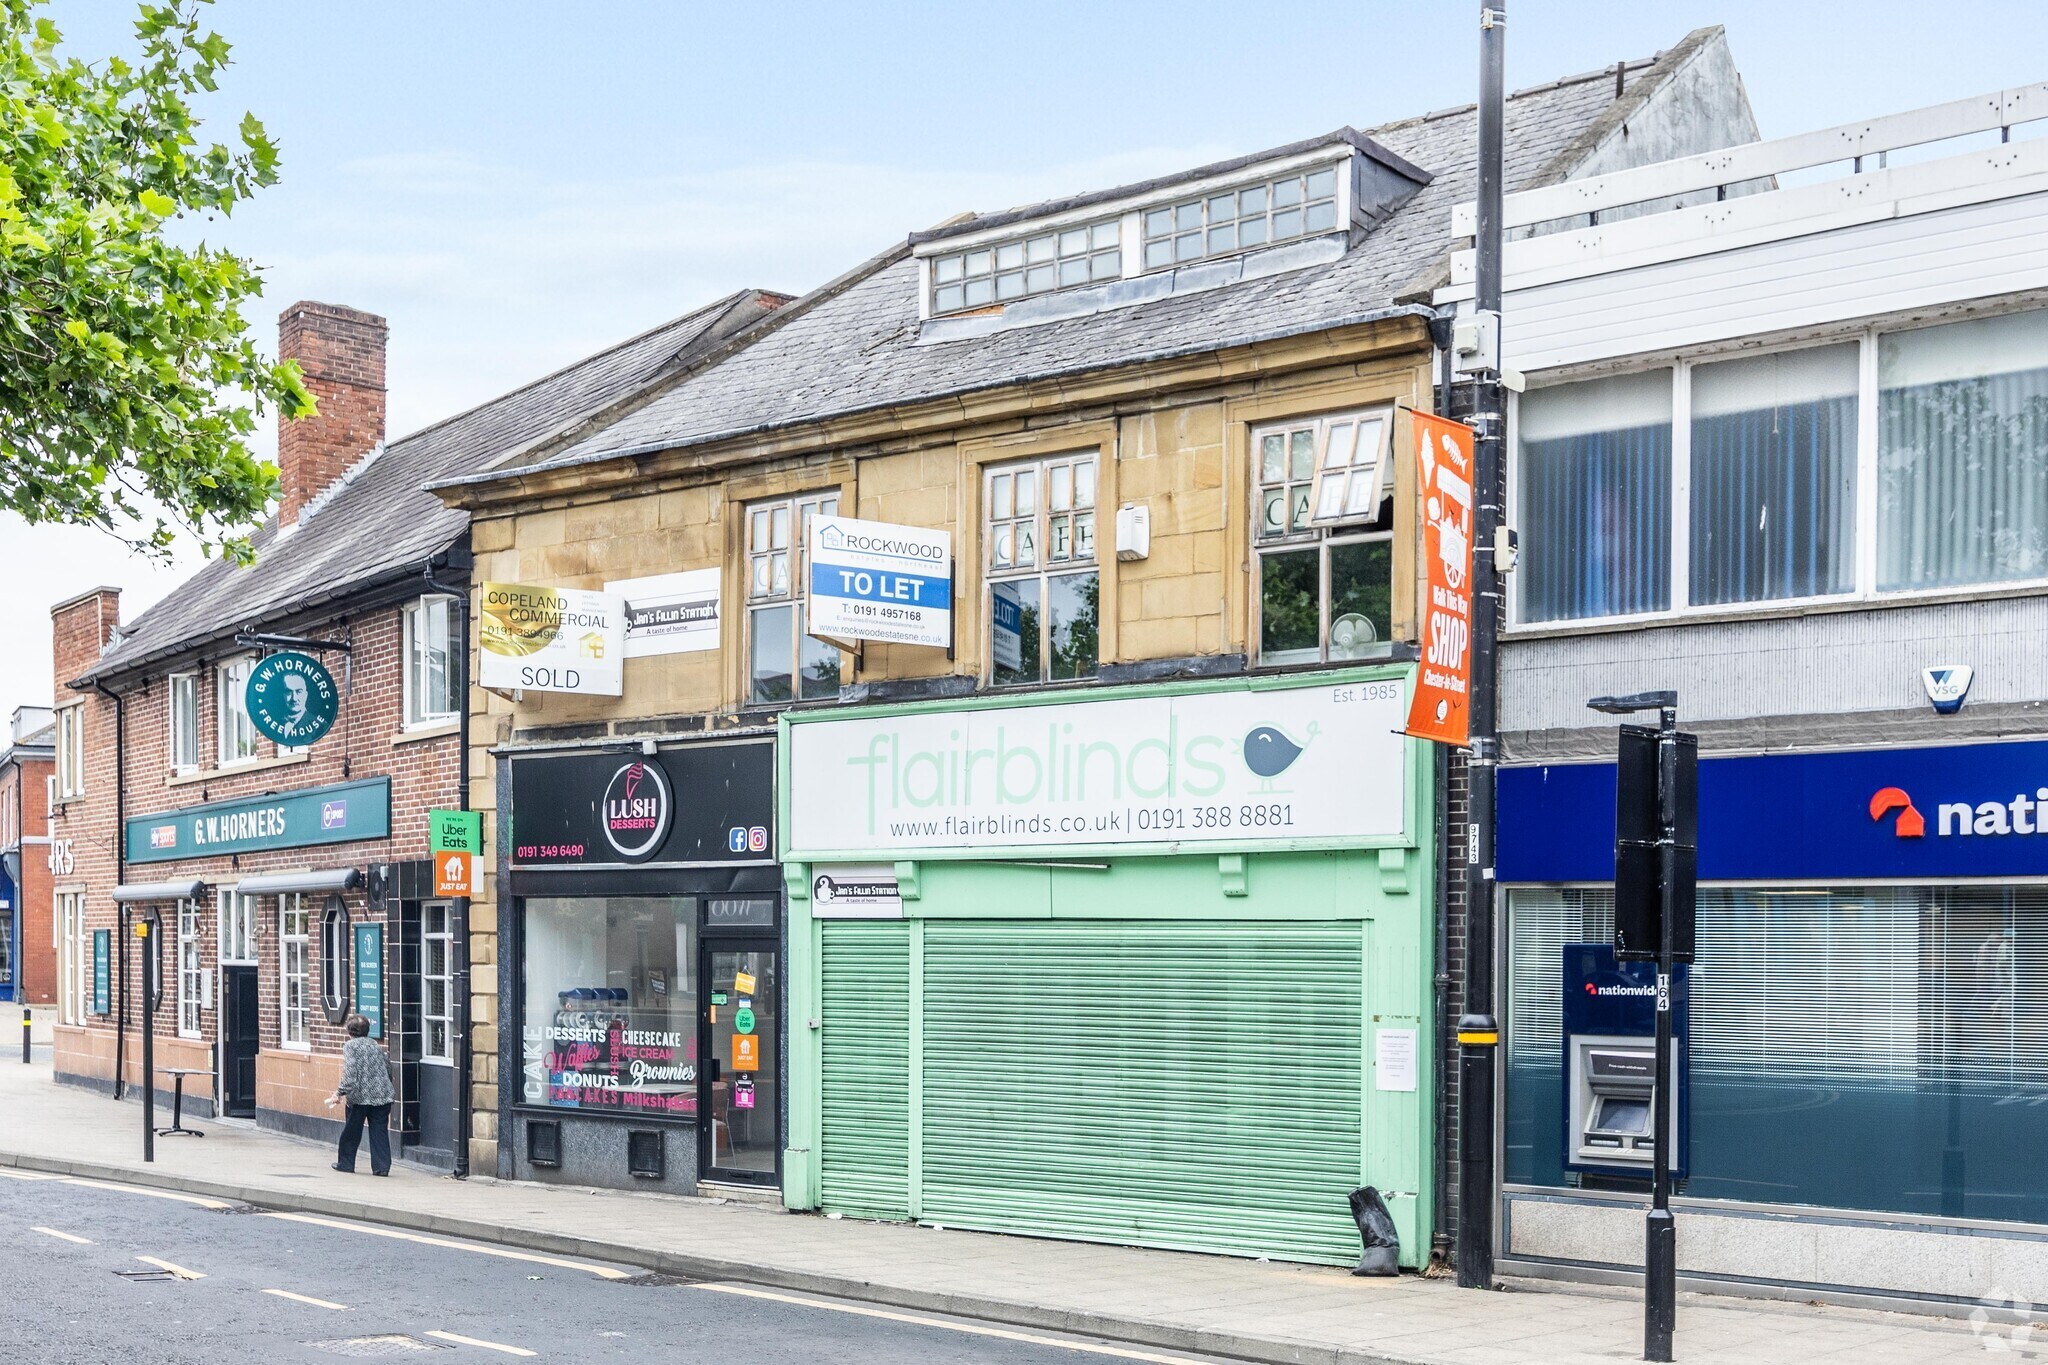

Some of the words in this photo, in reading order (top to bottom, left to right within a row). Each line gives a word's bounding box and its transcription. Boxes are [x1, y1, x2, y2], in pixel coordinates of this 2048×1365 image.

[847, 535, 943, 559] ROCKWOOD
[839, 570, 873, 595] TO
[880, 575, 925, 601] LET
[488, 591, 568, 610] COPELAND
[1446, 589, 1458, 612] This
[509, 607, 609, 629] COMMERCIAL
[842, 603, 851, 613] T:
[853, 605, 877, 616] 0191
[880, 608, 922, 621] 4957168
[487, 625, 513, 636] 0191
[672, 625, 688, 633] home
[818, 624, 943, 644] www.rockwoodestatesne.co.uk
[1428, 610, 1468, 671] SHOP
[274, 659, 331, 699] HORNERS
[521, 666, 580, 689] SOLD
[1333, 688, 1357, 702] Est.
[1361, 684, 1397, 701] 1985
[1933, 685, 1959, 695] VSG
[259, 708, 285, 734] FREE
[291, 714, 326, 737] HOUSE
[846, 714, 1226, 836] flairblinds
[610, 798, 657, 819] LUSH
[1938, 787, 2048, 836] nati
[221, 807, 286, 841] HORNERS
[442, 823, 467, 836] Uber
[610, 818, 656, 830] DESSERTS
[890, 810, 1121, 837] www.flairblinds.co.uk
[1138, 807, 1186, 830] 0191
[1192, 806, 1232, 828] 388
[1239, 804, 1294, 827] 8881
[442, 836, 468, 848] Eats
[518, 845, 538, 858] 0191
[540, 845, 558, 857] 349
[559, 844, 584, 857] 6490
[1470, 824, 1478, 863] 9743
[440, 882, 455, 891] JUST
[1658, 975, 1667, 1010] 164
[545, 1026, 606, 1043] DESSERTS
[622, 1030, 681, 1047] CHEESECAKE
[523, 1025, 543, 1099] CAKE
[544, 1042, 600, 1075] Waffles
[622, 1047, 638, 1059] ICE
[639, 1048, 675, 1060] CREAM
[562, 1072, 619, 1089] DONUTS
[629, 1059, 697, 1089] Brownies
[548, 1085, 618, 1104] PANCAKES
[623, 1091, 697, 1111] Milkshakes
